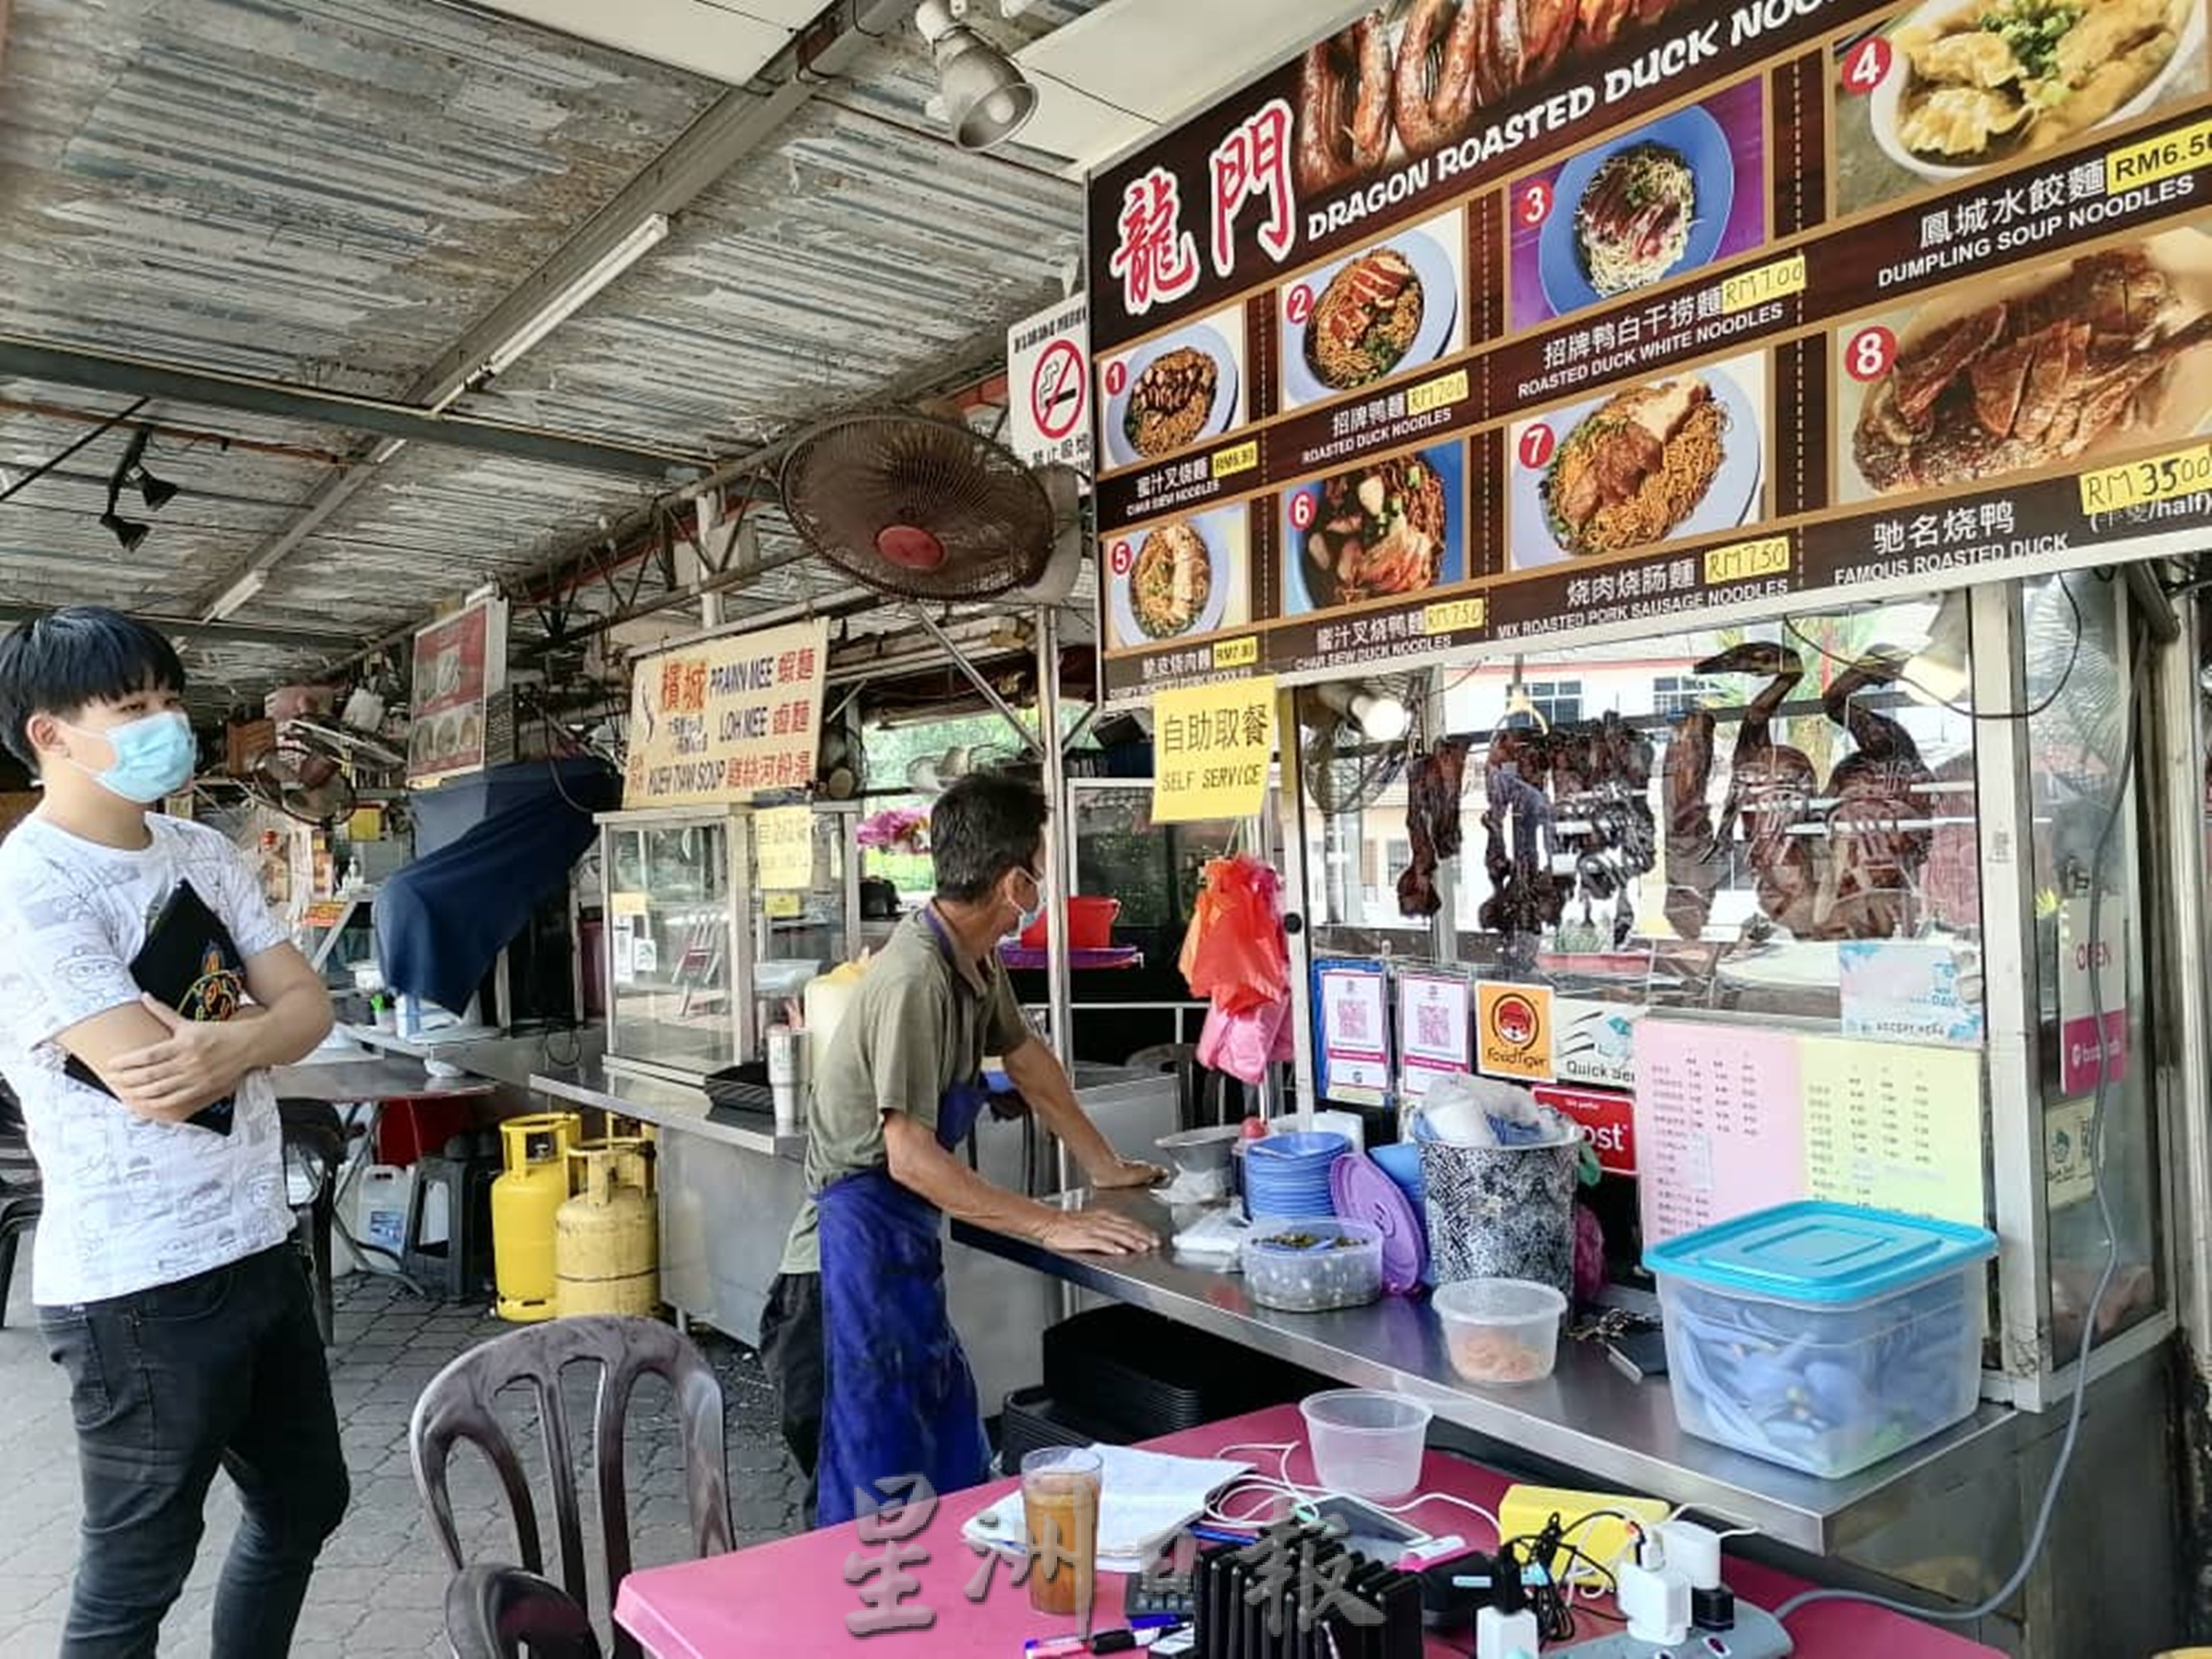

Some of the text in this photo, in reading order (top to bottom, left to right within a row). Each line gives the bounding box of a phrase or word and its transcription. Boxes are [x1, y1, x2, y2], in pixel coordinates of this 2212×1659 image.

[1850, 43, 1881, 85] 4
[1307, 156, 1431, 242] DRAGON
[1437, 84, 1596, 183] ROASTED
[1603, 21, 1721, 101] DUCK
[2115, 131, 2212, 183] RM6.5
[1111, 98, 1296, 315] 龍門
[1525, 187, 1545, 222] 3
[1920, 157, 2106, 249] 鳳城水餃麵
[1878, 173, 2195, 288] DUMPLING SOUP NOODLES
[1290, 291, 1309, 317] 2
[1518, 302, 1785, 397] ROASTED DUCK WHITE NOODLES
[1856, 333, 1885, 376] 8
[1301, 407, 1452, 465] ROASTED DUCK NOODLES
[1527, 429, 1545, 464] 7
[1295, 498, 1310, 524] 6
[1874, 500, 2015, 555] 驰名烧鸭
[1115, 544, 1128, 569] 5
[1834, 533, 2070, 585] FAMOUS ROASTED DUCK
[1497, 578, 1789, 641] MIX ROASTED PORK SAUSAGE NOODLES
[1393, 634, 1451, 657] NOODLES
[749, 657, 774, 691] MEE
[742, 707, 767, 739] MEE
[1164, 704, 1269, 754] 自助取餐
[1162, 765, 1262, 792] SELF SERVICE
[1567, 1060, 1608, 1078] Quick
[1583, 1122, 1624, 1151] ost
